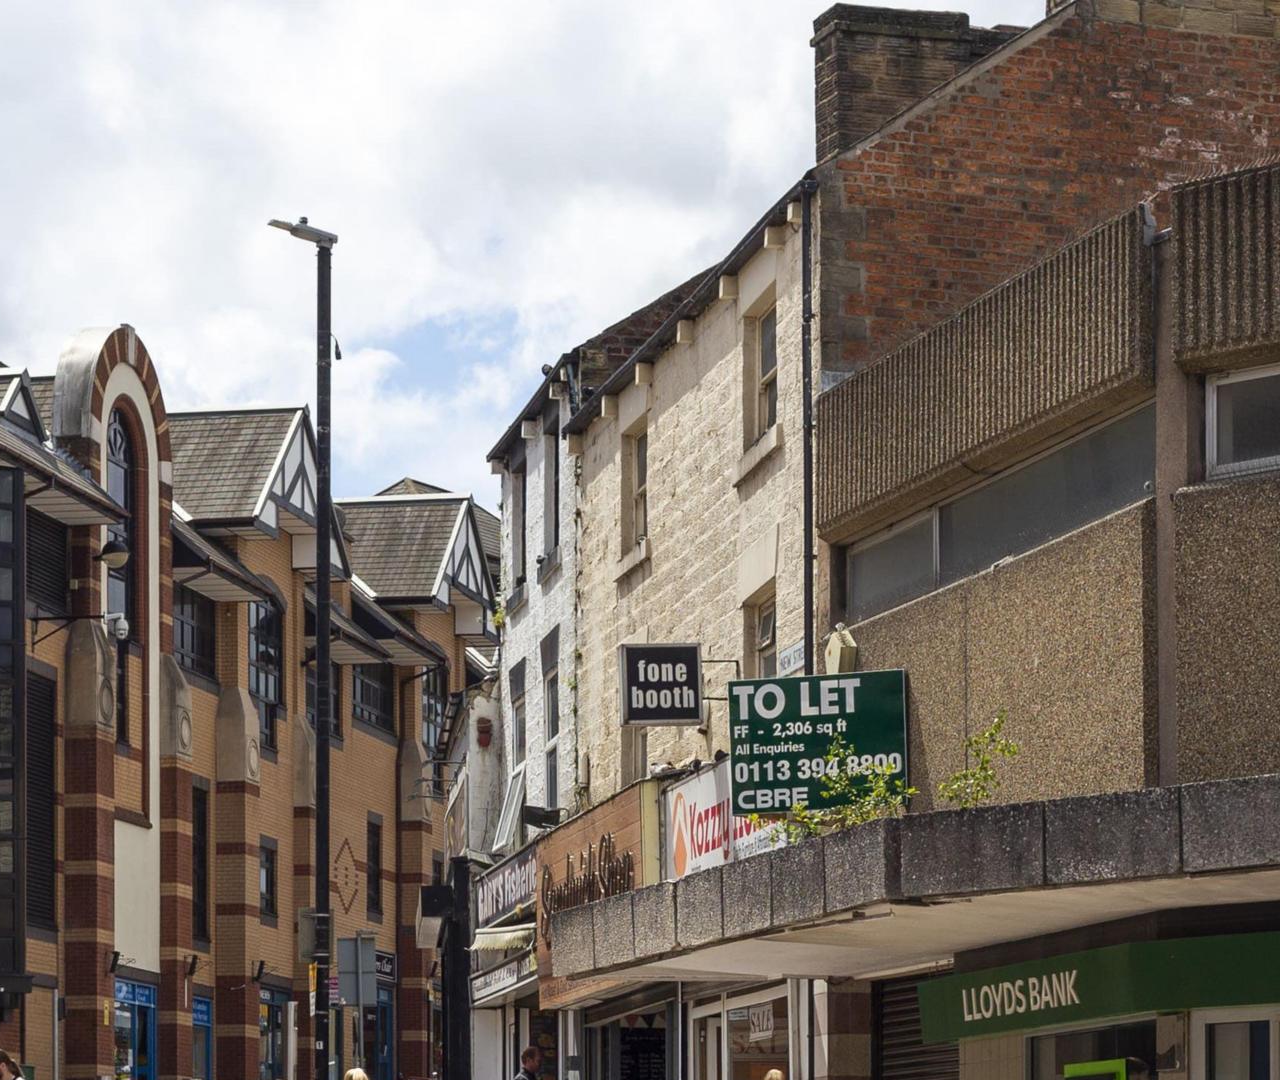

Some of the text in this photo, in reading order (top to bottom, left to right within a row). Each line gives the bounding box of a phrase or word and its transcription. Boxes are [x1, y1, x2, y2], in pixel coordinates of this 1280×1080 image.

[637, 660, 687, 682] fone
[631, 686, 695, 709] booth
[732, 678, 861, 720] TO LET
[734, 725, 749, 739] FF
[772, 721, 813, 738] 2,306
[816, 722, 833, 737] sq
[836, 718, 847, 733] ft
[735, 741, 805, 756] All Enquiries
[734, 752, 902, 783] 0113 394 8800
[737, 786, 809, 809] CBRE
[962, 969, 1080, 1022] LLOYDS BANK
